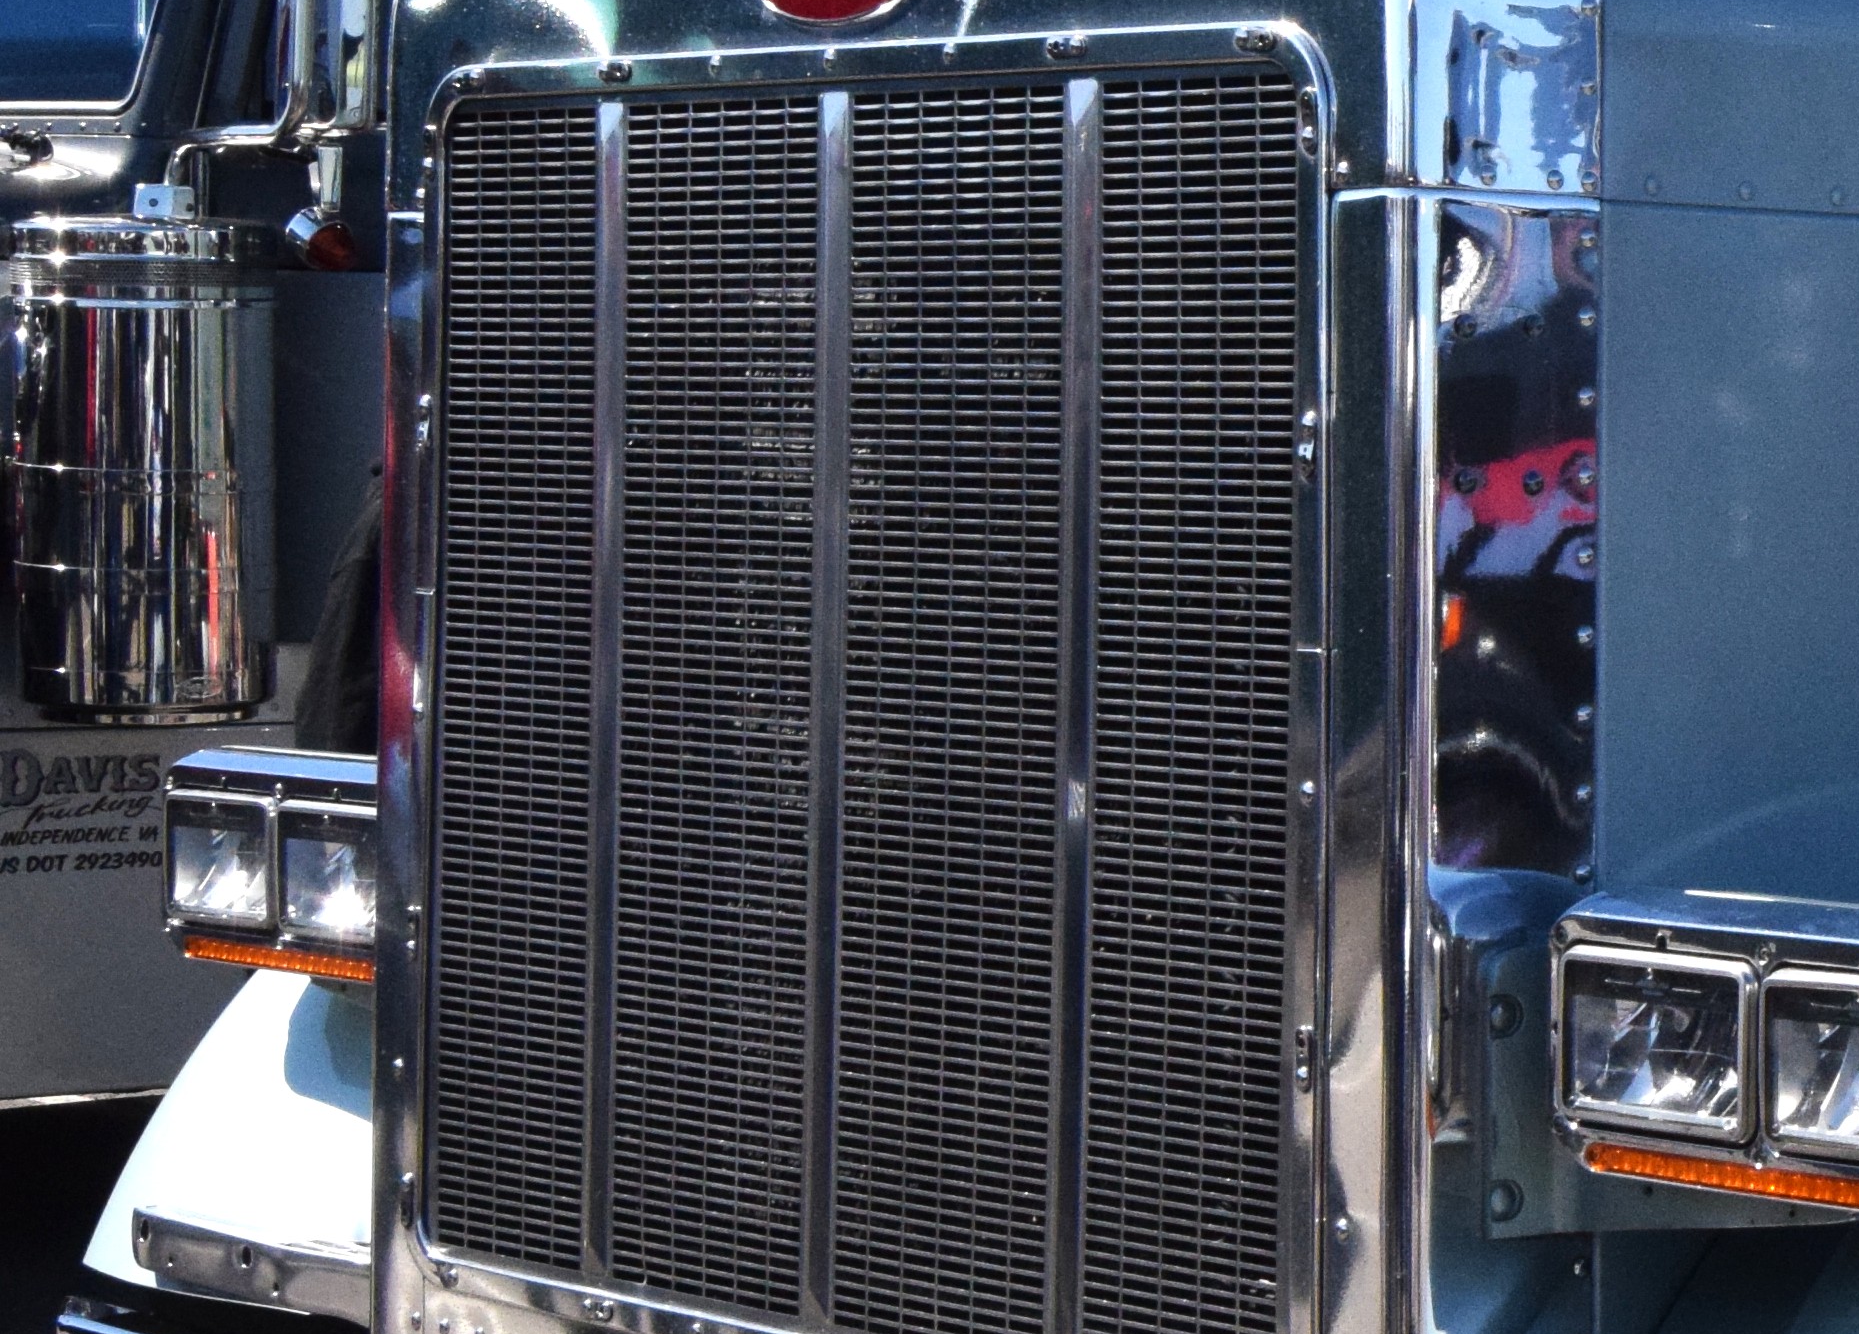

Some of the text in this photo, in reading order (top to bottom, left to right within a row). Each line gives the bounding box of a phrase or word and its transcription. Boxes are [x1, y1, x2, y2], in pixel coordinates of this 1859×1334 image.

[0, 748, 160, 807] DAVIS
[138, 825, 159, 842] VA
[26, 854, 68, 873] DOT
[74, 851, 163, 871] 2923490
